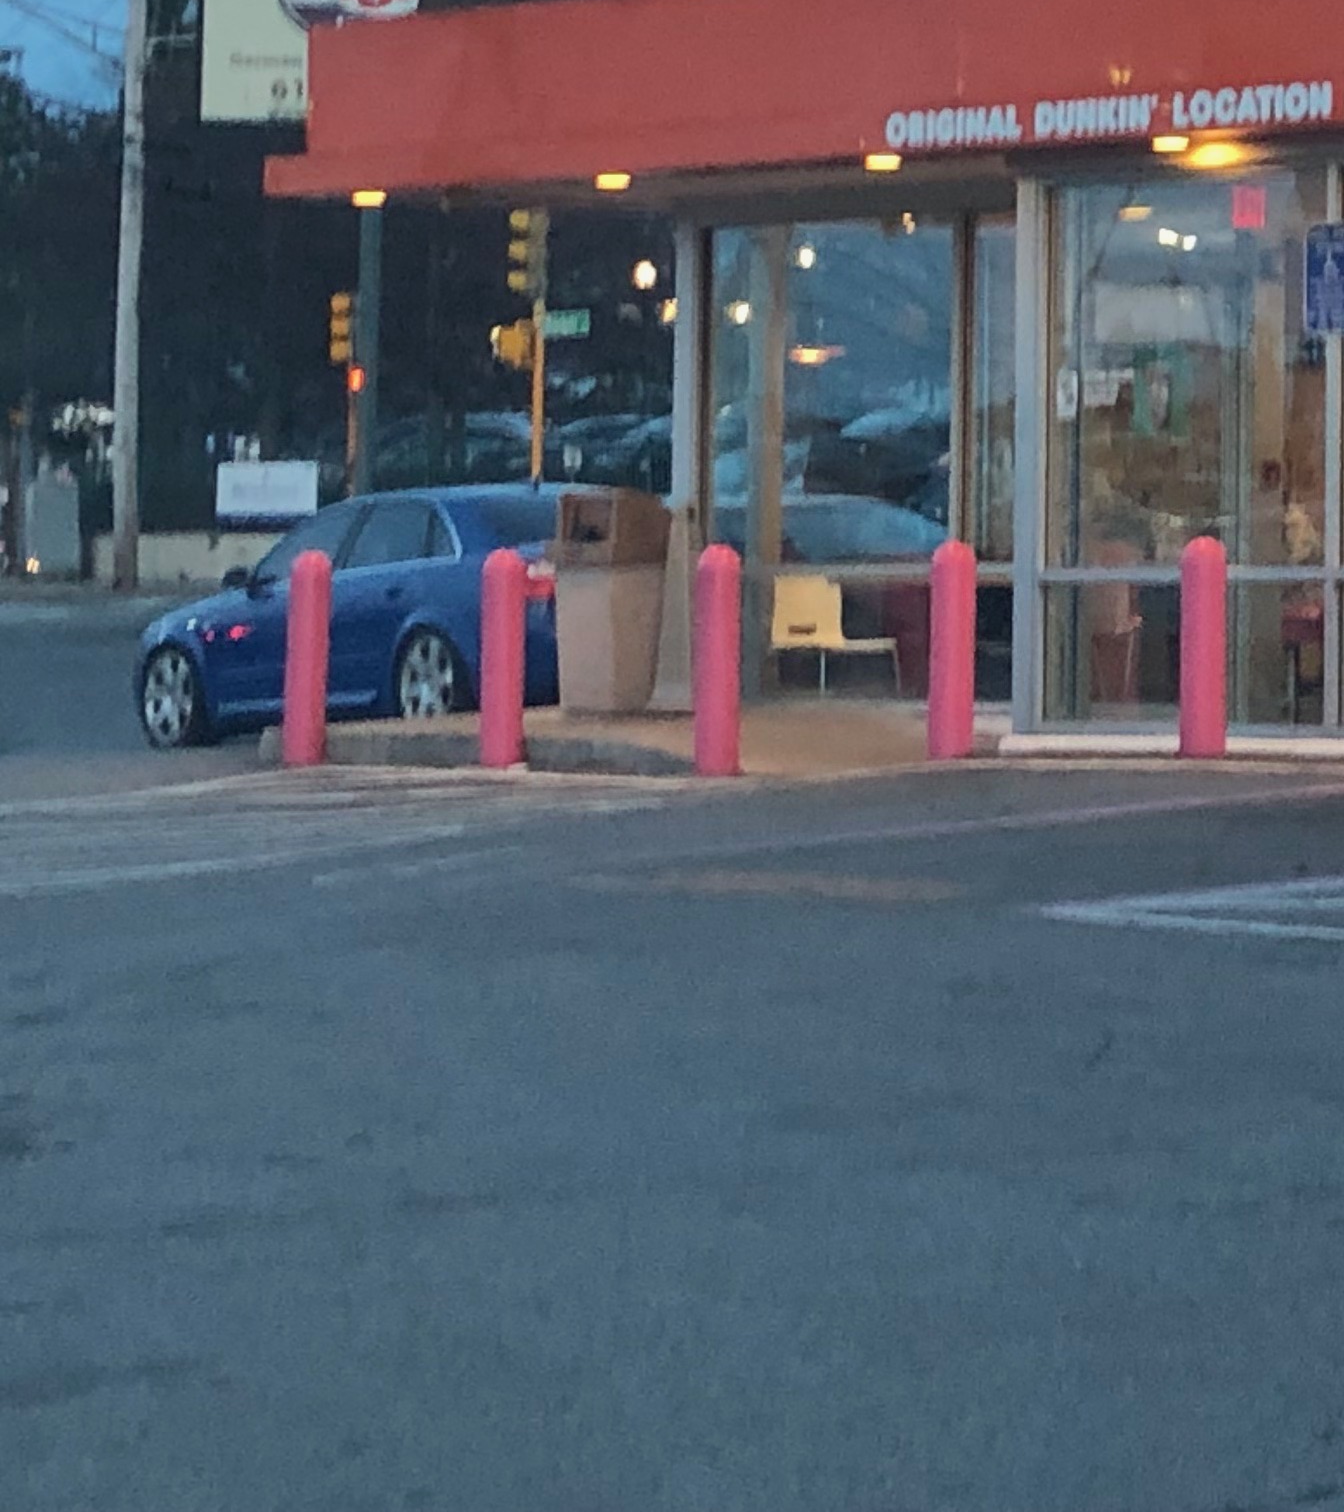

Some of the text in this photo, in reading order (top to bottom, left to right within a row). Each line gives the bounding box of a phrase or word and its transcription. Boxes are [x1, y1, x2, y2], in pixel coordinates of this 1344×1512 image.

[885, 104, 1022, 149] ORIGINAL
[1033, 93, 1158, 139] DUNKIN'
[1172, 80, 1333, 129] LOCATION
